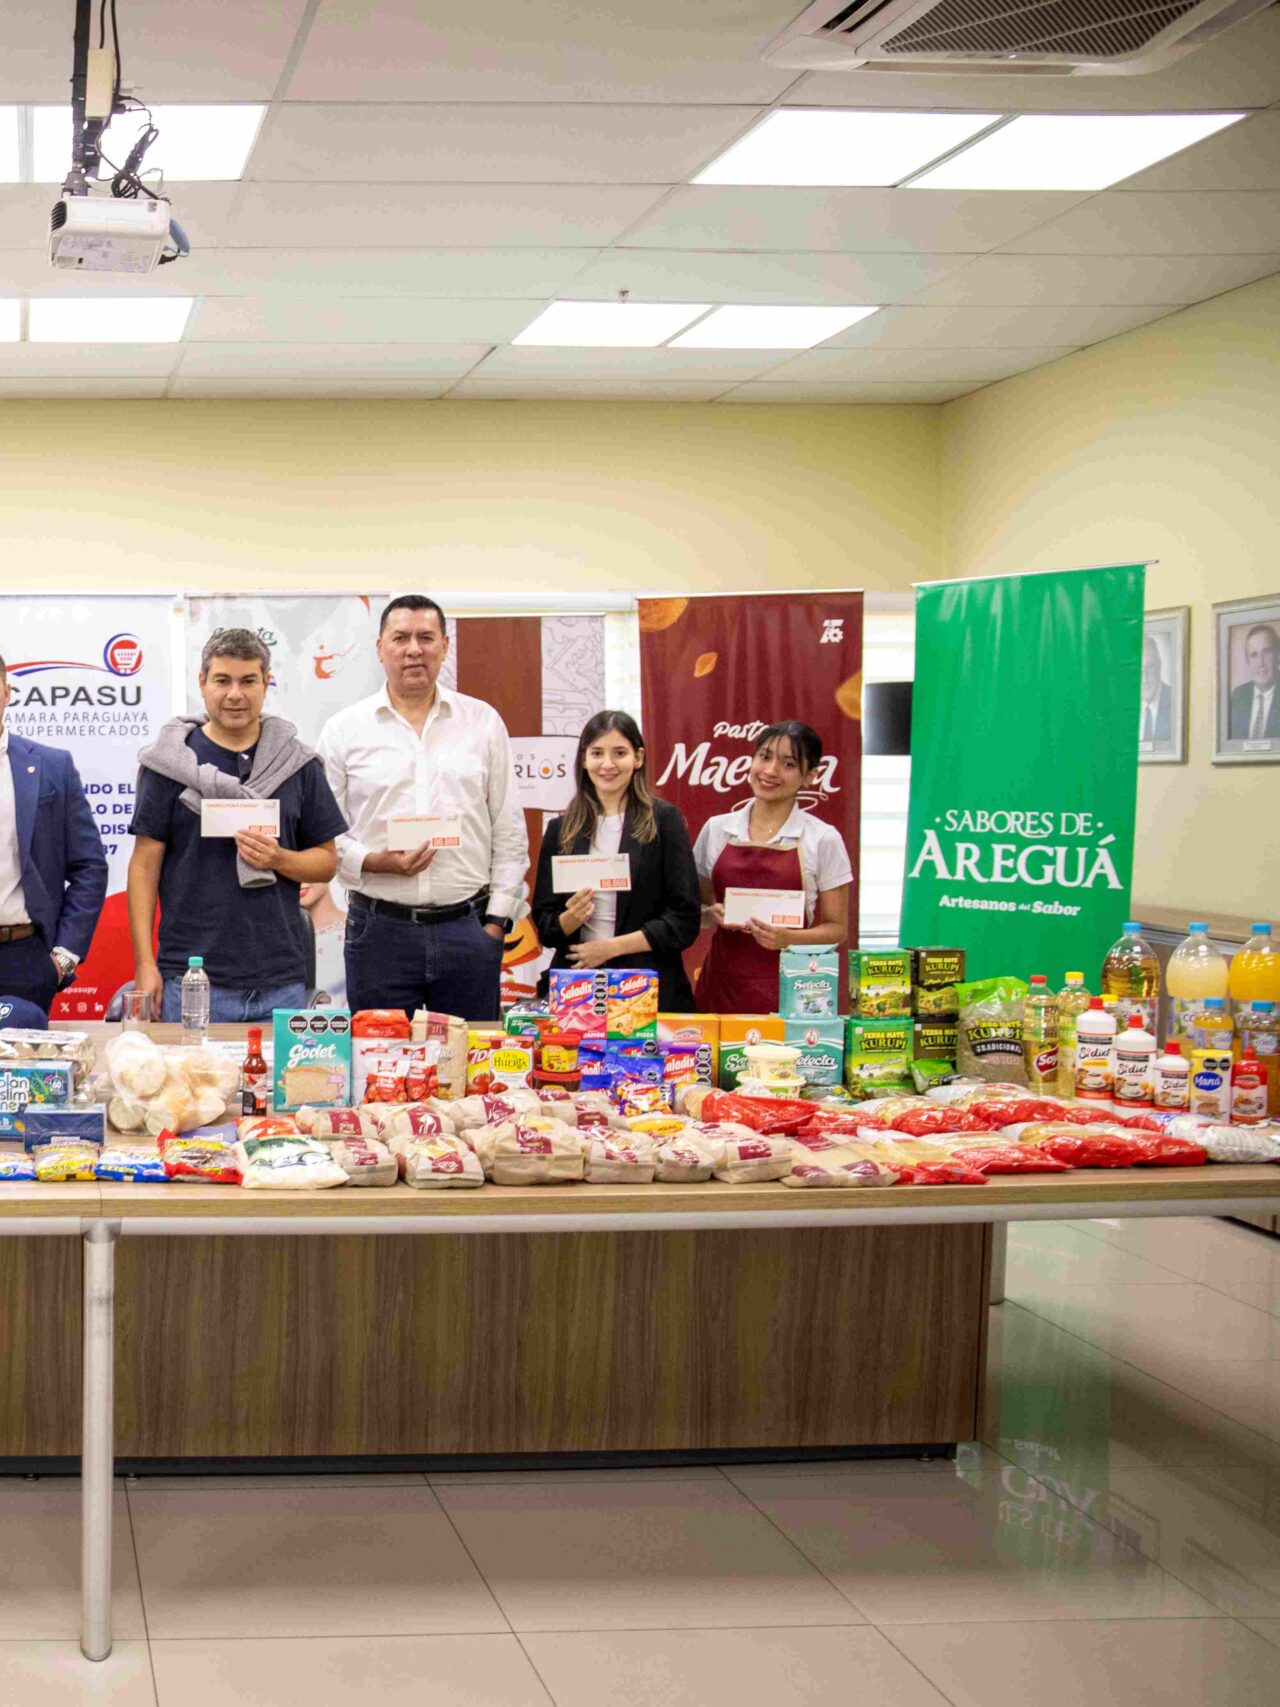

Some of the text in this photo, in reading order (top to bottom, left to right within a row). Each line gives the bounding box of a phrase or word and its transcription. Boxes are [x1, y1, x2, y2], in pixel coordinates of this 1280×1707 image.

[4, 711, 149, 723] AMARA PARAGUAYA
[16, 725, 150, 737] SUPERMERCADOS
[944, 809, 1094, 839] SABORES DE
[907, 829, 1124, 890] AREGUÁ
[938, 894, 1017, 912] Artesanos
[1031, 900, 1081, 916] Sabor
[619, 976, 648, 992] Saladix
[794, 979, 832, 991] Selecta
[560, 982, 593, 1003] Saladix
[287, 1043, 337, 1069] Godet
[665, 1055, 696, 1071] aladix
[796, 1053, 838, 1070] electa
[0, 1088, 27, 1101] slim
